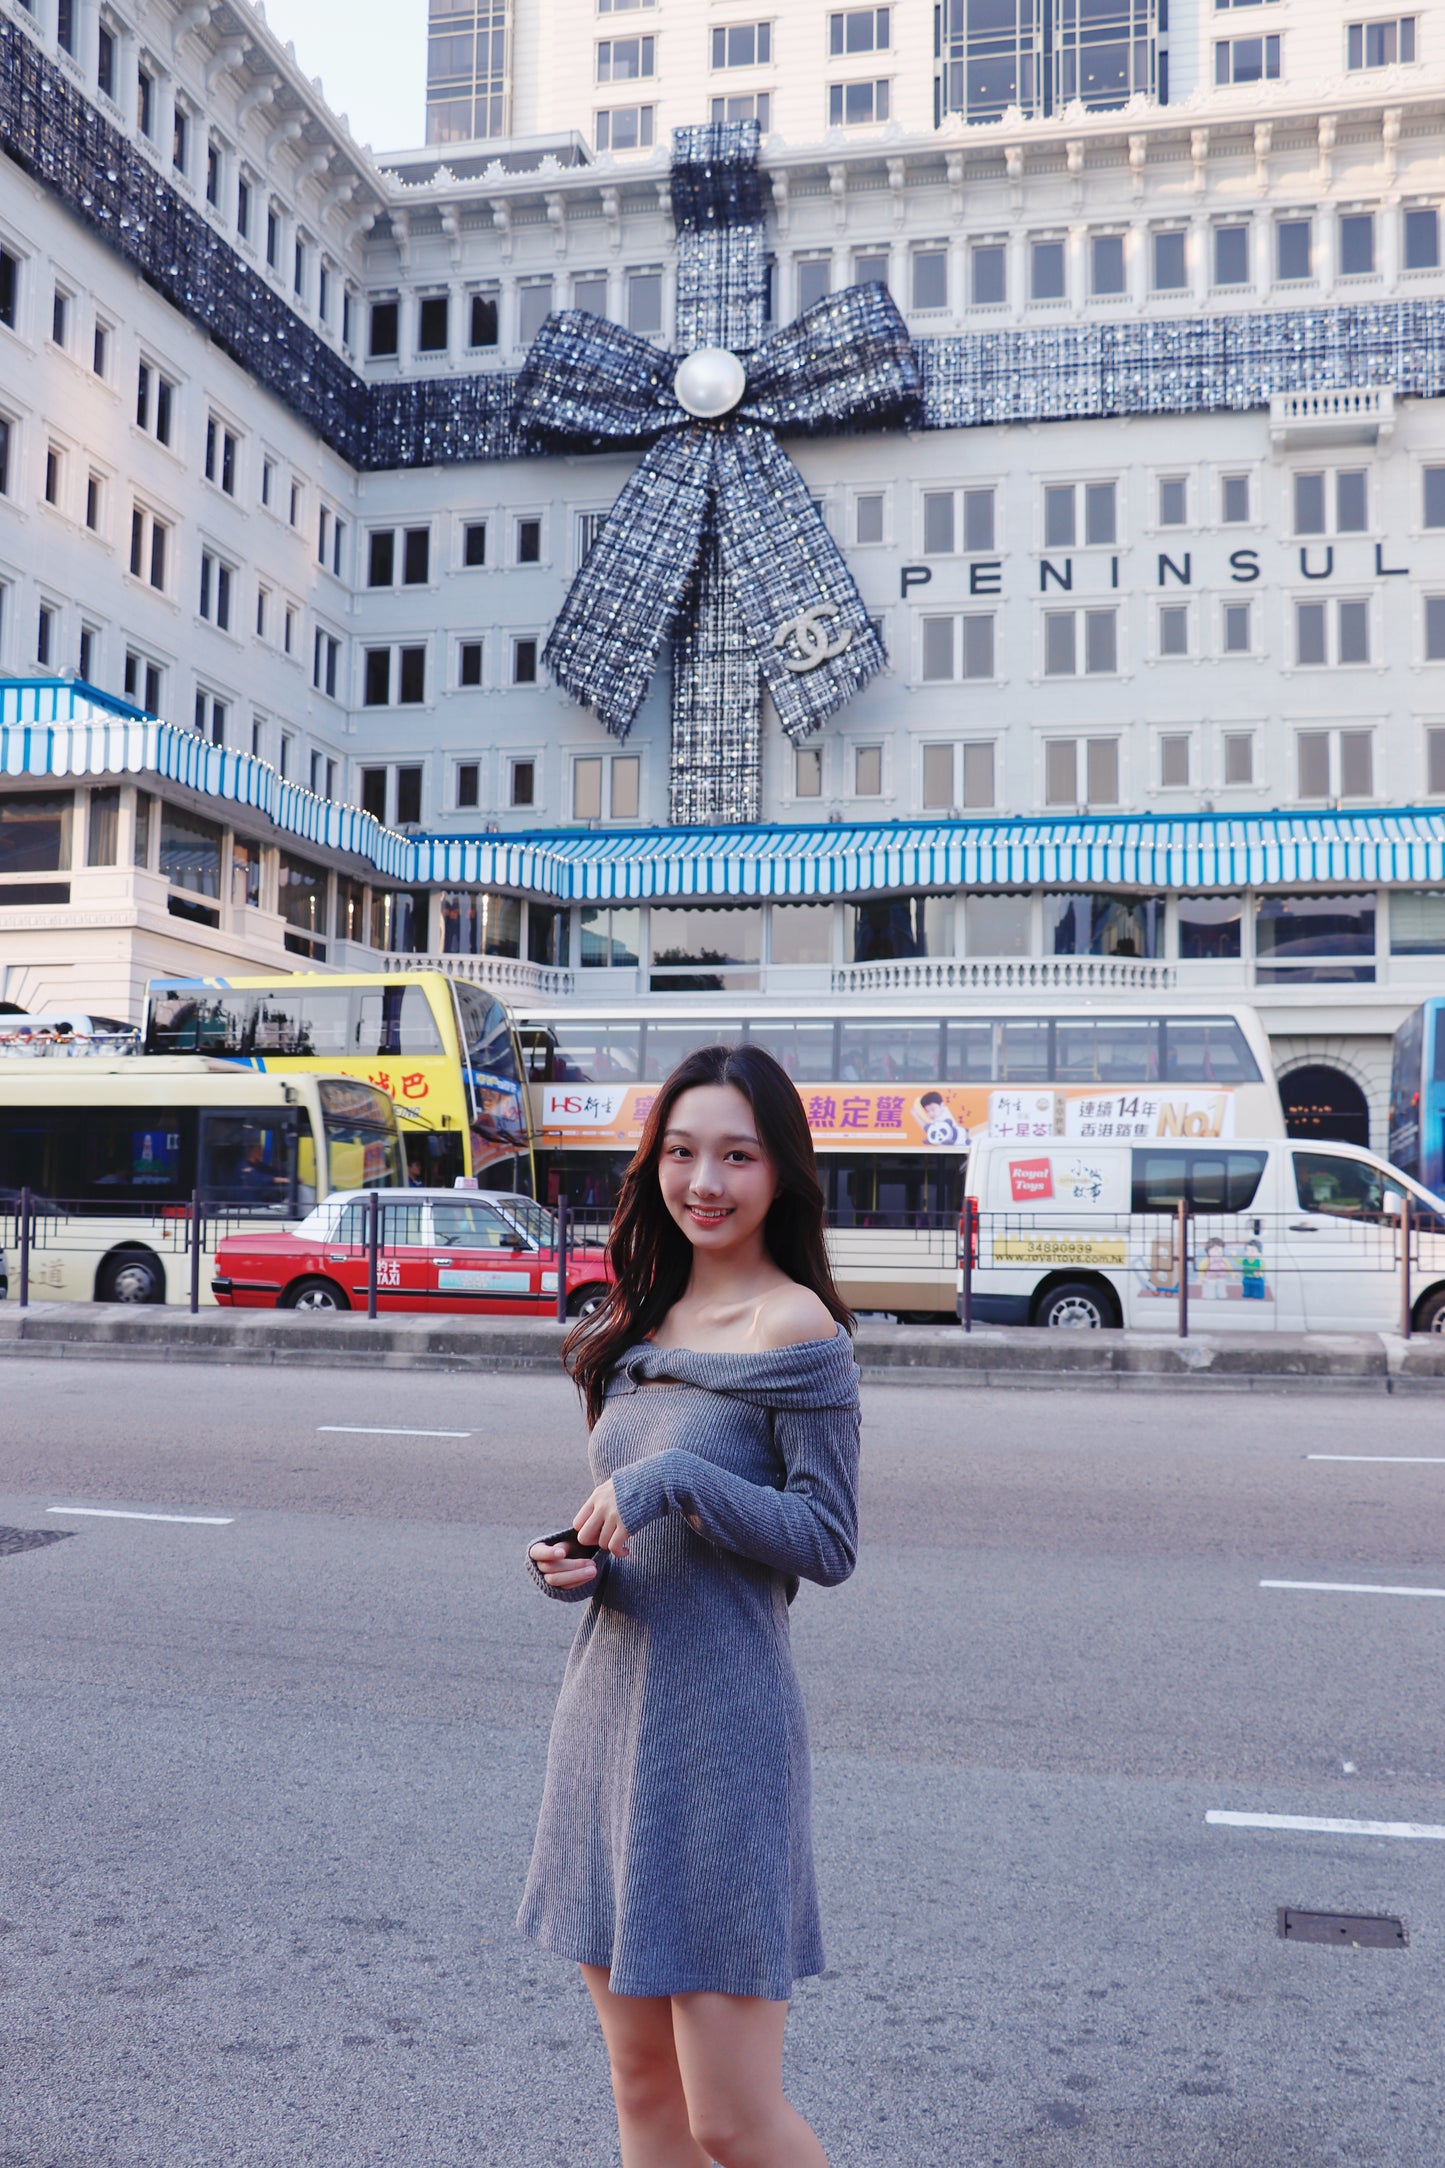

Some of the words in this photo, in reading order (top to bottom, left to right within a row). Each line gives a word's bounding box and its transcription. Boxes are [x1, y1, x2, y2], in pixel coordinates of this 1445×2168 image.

[900, 542, 1410, 599] PENINSUL
[551, 1096, 582, 1113] HS
[808, 1095, 906, 1128] 熱定驚
[1012, 1168, 1049, 1180] Royal
[1016, 1180, 1045, 1192] Toys
[376, 1272, 400, 1286] TAXI
